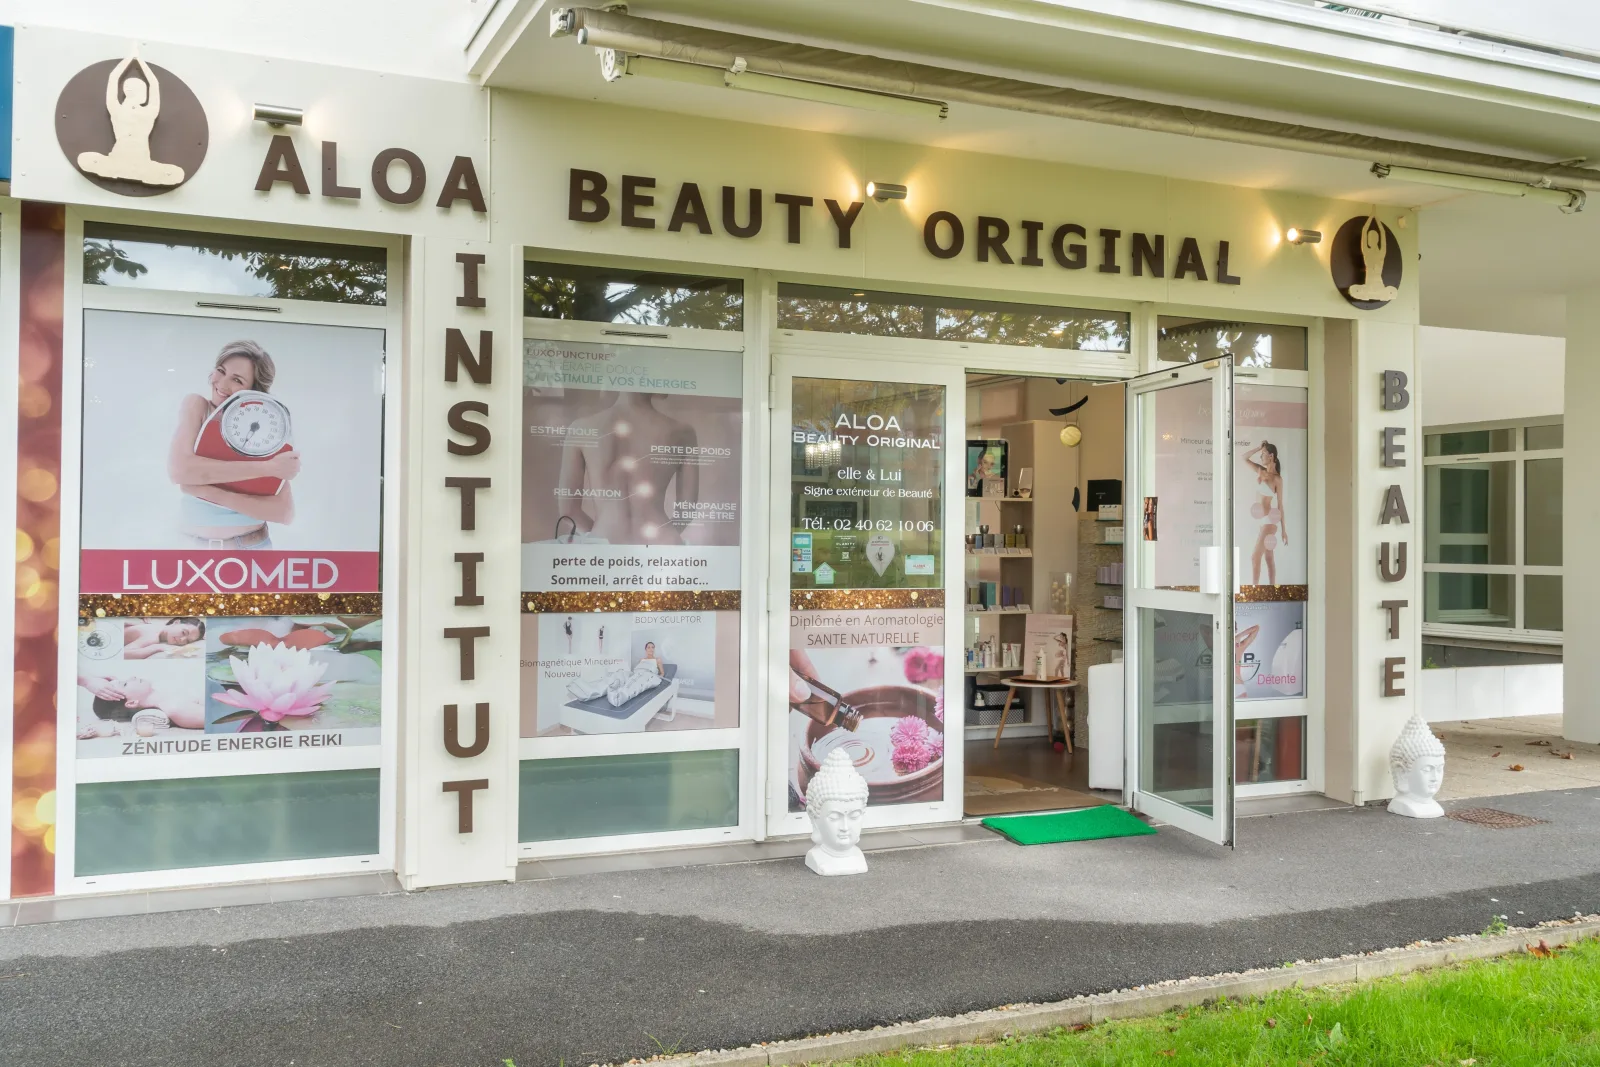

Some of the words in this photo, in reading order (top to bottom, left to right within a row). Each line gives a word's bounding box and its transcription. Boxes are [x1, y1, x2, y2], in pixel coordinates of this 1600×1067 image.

[254, 135, 487, 213] ALOA
[568, 167, 865, 249] BEAUTY
[924, 210, 1240, 286] ORIGINAL
[606, 364, 649, 376] DOUCE
[554, 372, 604, 385] STIMULE
[608, 376, 638, 386] VOS
[639, 376, 697, 390] ÉNERGIES
[835, 413, 901, 431] ALOA
[530, 425, 598, 437] ESTHÉTIQUE
[793, 431, 859, 446] BEAUTY
[867, 435, 941, 450] ORIGINAL
[650, 445, 684, 454] PERTE
[685, 446, 699, 455] DE
[700, 447, 731, 456] POIDS
[837, 466, 862, 480] elle
[866, 469, 876, 481] &
[880, 469, 902, 481] Lui
[553, 488, 621, 498] RELAXATION
[804, 485, 833, 498] Signe
[882, 488, 896, 497] de
[898, 488, 933, 499] Beauté
[673, 501, 737, 511] MÉNOPAUSE
[672, 510, 680, 519] &
[681, 509, 735, 520] BIEN-ÊTRE
[834, 519, 851, 531] 02
[855, 519, 873, 531] 40
[876, 519, 892, 531] 62
[898, 520, 913, 532] 10
[916, 520, 934, 532] 06
[1381, 369, 1410, 697] BEAUTE
[444, 252, 493, 834] INSTITUT
[552, 556, 586, 569] perte
[589, 555, 605, 567] de
[608, 555, 644, 569] poids,
[647, 556, 708, 567] relaxation
[123, 557, 339, 593] LUXOMED
[551, 574, 609, 587] Sommeil,
[612, 574, 643, 585] arrêt
[647, 574, 662, 585] du
[635, 616, 658, 624] BODY
[660, 615, 702, 624] SCULPTOR
[791, 614, 842, 630] Diplômé
[845, 617, 860, 626] en
[864, 614, 944, 628] Aromatologie
[807, 633, 847, 646] SANTE
[851, 632, 920, 645] NATURELLE
[519, 657, 582, 669] Biomagnétique
[544, 670, 581, 679] Nouveau
[1257, 674, 1297, 685] Détente
[122, 739, 212, 756] ZÉNITUDE
[217, 735, 293, 751] ENERGIE
[299, 733, 342, 747] REIKI
